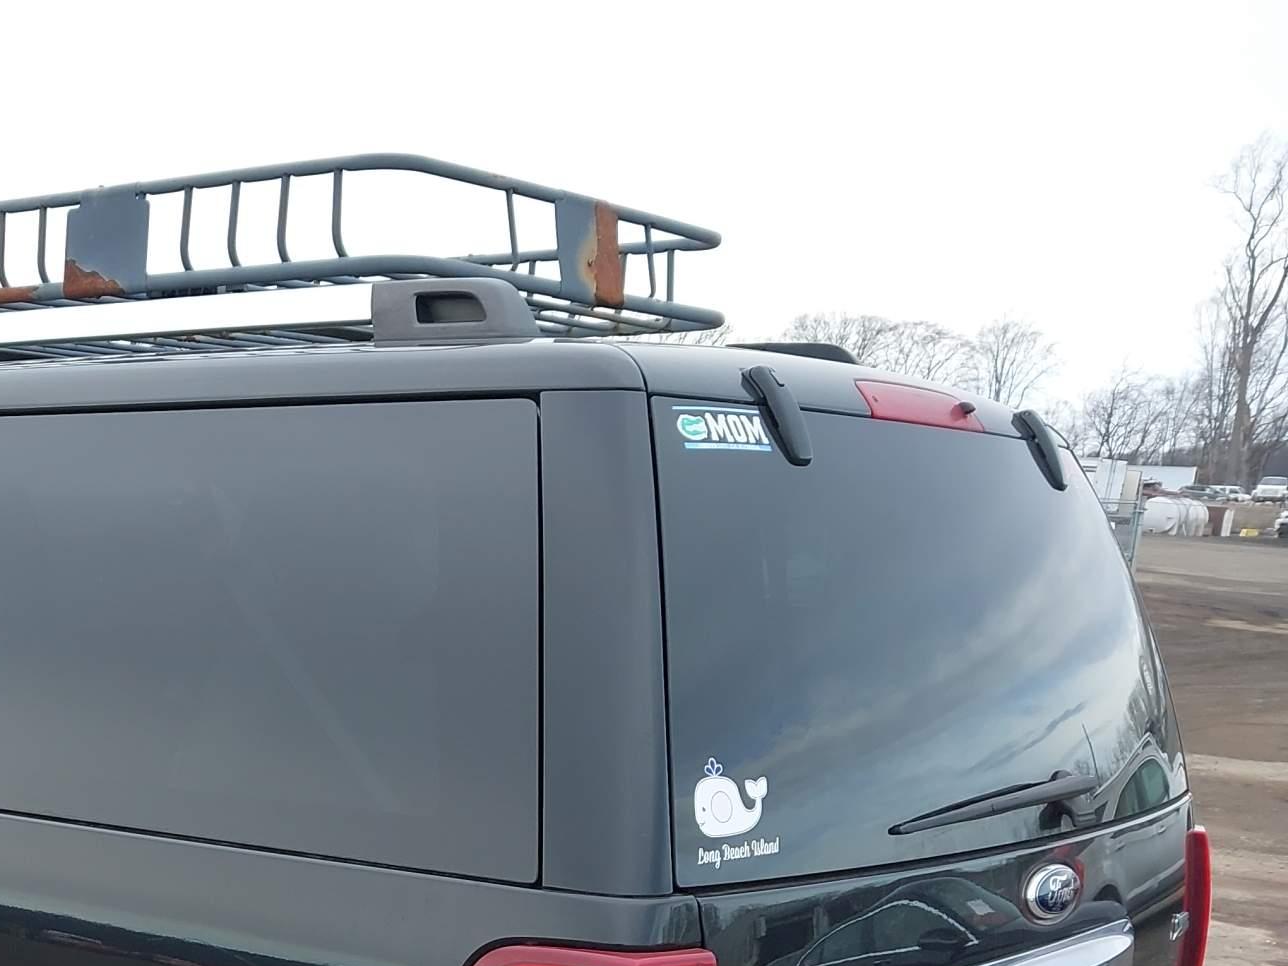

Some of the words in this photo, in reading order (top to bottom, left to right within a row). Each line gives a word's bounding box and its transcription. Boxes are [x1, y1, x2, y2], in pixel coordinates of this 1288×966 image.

[704, 412, 770, 445] MOM
[697, 847, 721, 869] Long
[722, 841, 751, 861] Beach
[751, 836, 780, 857] Island
